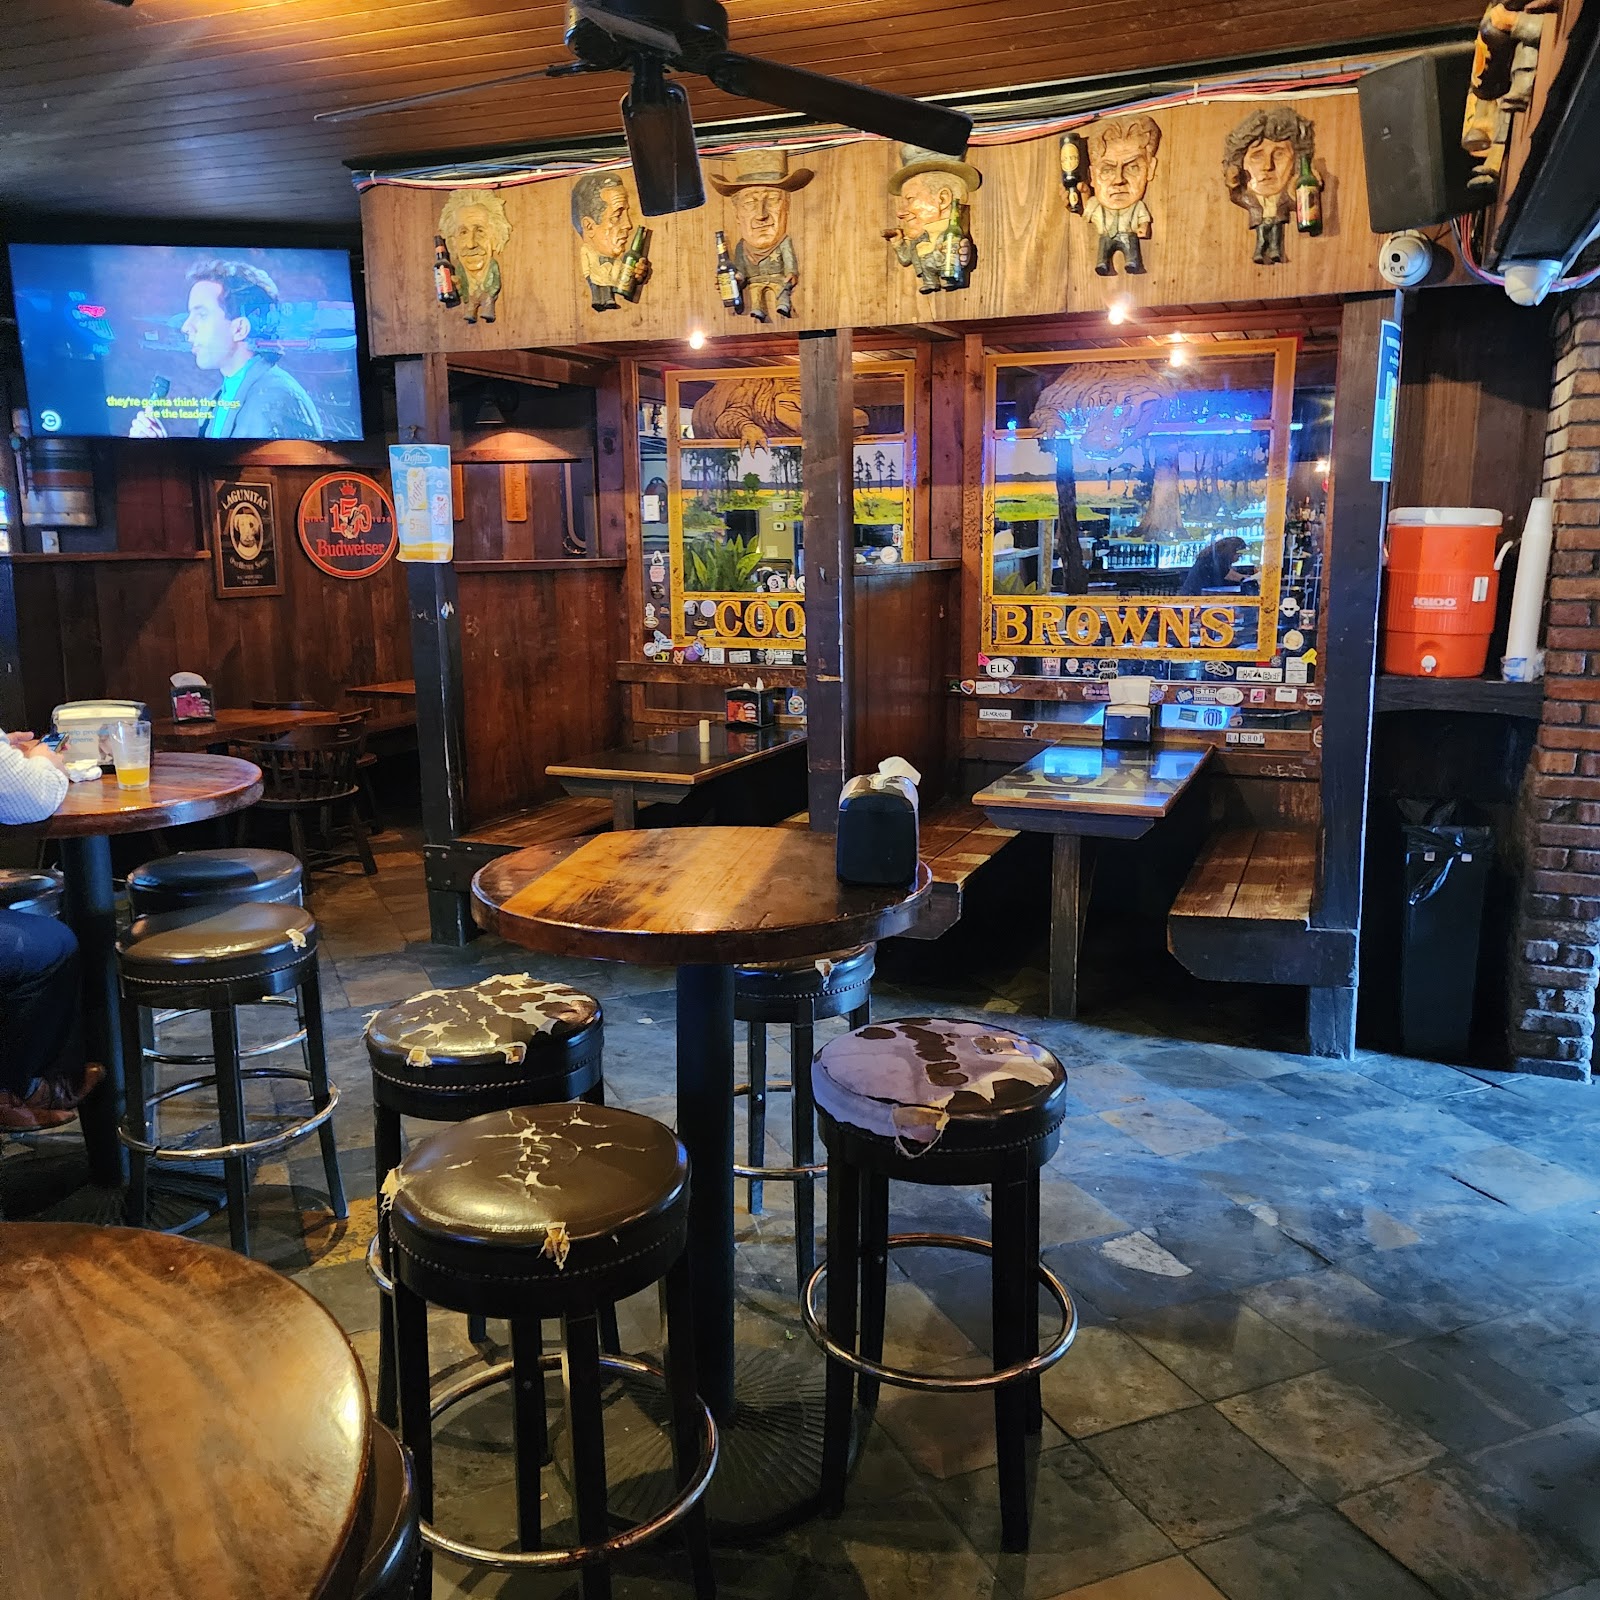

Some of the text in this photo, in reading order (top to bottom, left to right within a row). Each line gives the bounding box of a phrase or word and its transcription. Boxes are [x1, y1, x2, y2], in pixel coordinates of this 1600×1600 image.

[106, 395, 140, 408] they're
[142, 399, 172, 408] gonna
[173, 396, 199, 407] think
[200, 396, 217, 407] the
[161, 408, 179, 418] the
[180, 409, 214, 419] leaders.
[220, 489, 269, 510] LAGUNITAS
[316, 539, 385, 557] Budweiser
[1413, 596, 1457, 607] IGLOO
[714, 600, 806, 638] COO
[993, 605, 1236, 648] BROWN'S
[990, 664, 1010, 673] ELK
